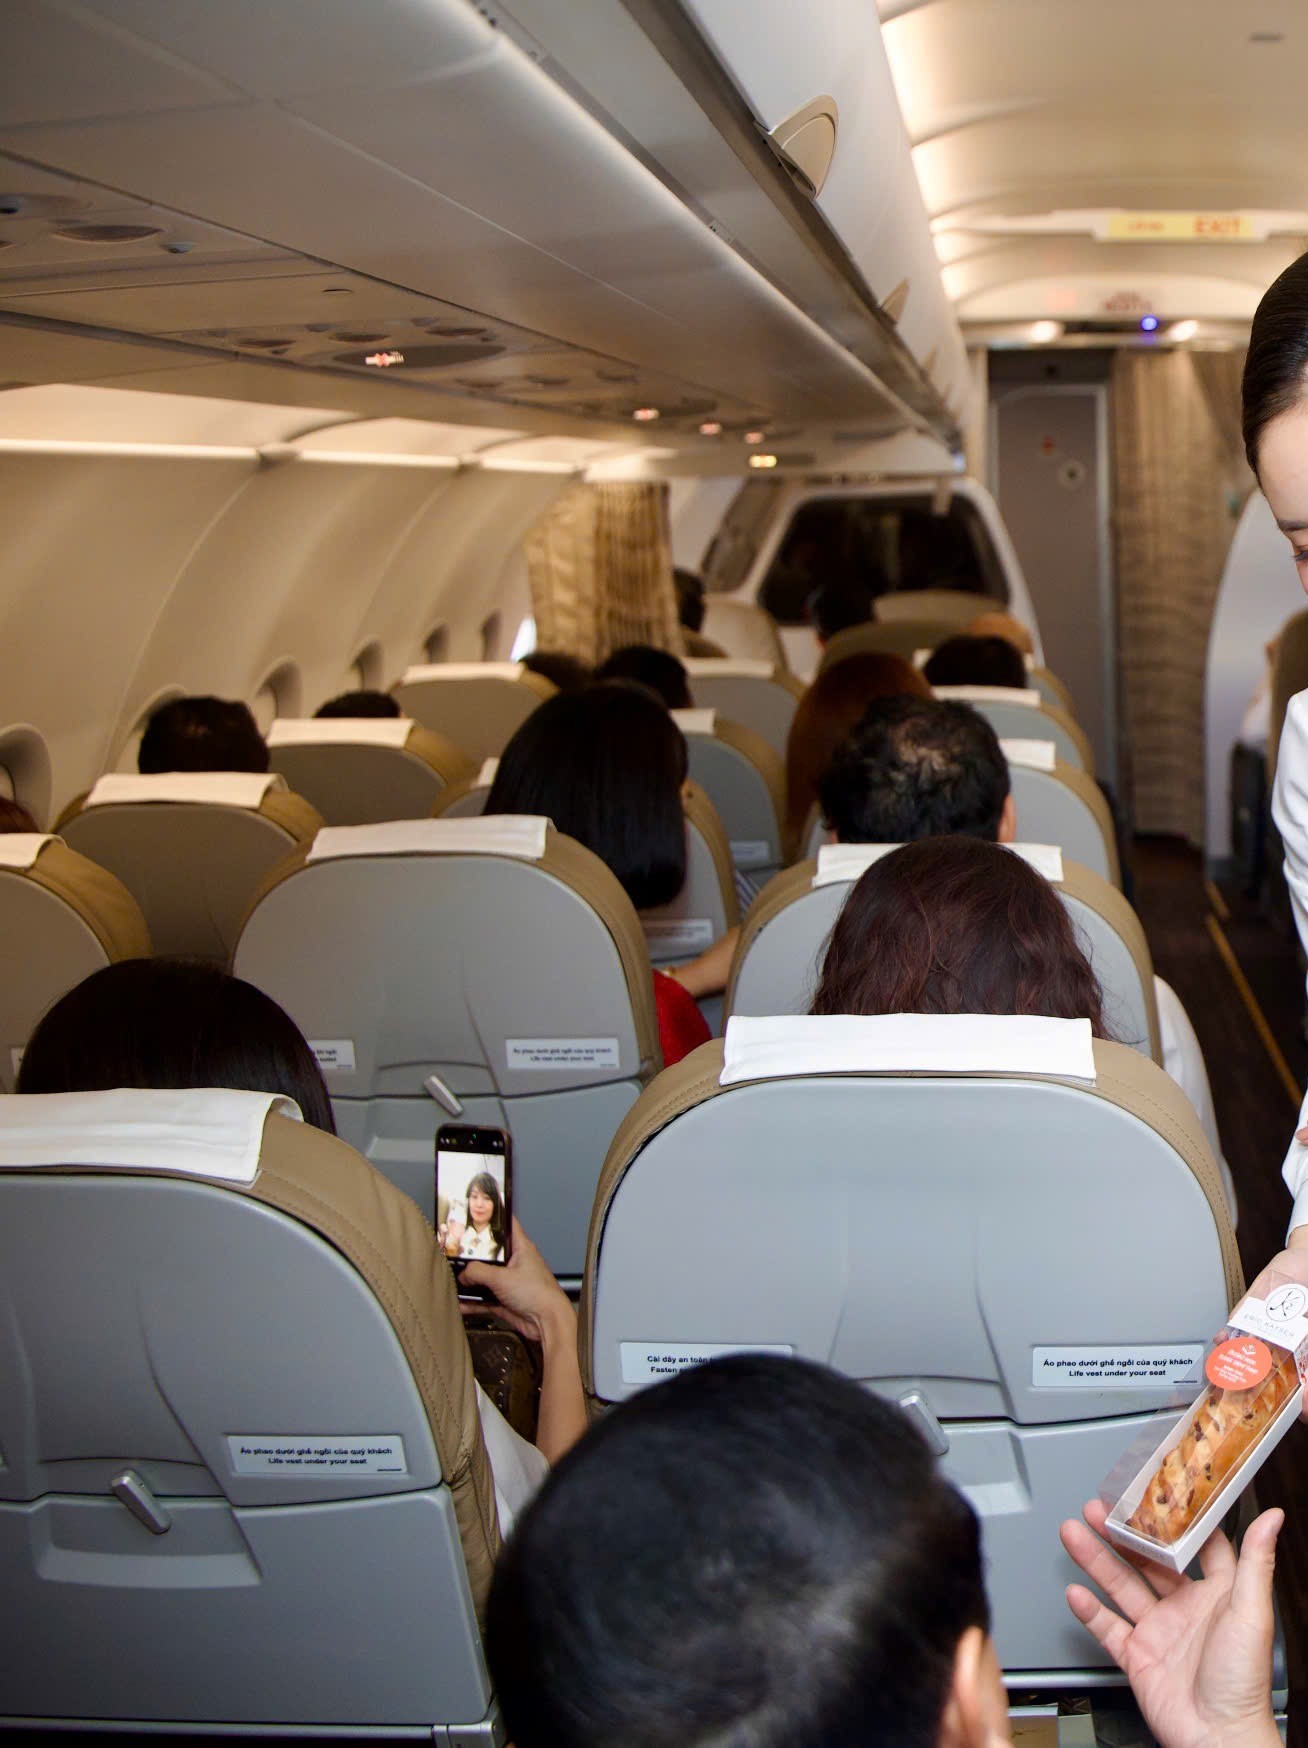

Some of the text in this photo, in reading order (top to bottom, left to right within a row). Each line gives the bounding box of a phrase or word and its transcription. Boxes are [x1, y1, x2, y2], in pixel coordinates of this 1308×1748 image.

[1194, 215, 1241, 233] EXIT
[1043, 1358, 1055, 1367] Áo
[1056, 1360, 1077, 1368] phao
[1078, 1359, 1098, 1367] dưới
[1099, 1358, 1115, 1368] ghế
[1116, 1358, 1134, 1368] ngồi
[1136, 1358, 1151, 1366] của
[1152, 1359, 1167, 1367] quý
[1104, 1369, 1127, 1377] under
[1129, 1370, 1147, 1378] your
[240, 1446, 252, 1455] Áo
[253, 1448, 274, 1456] phao
[350, 1447, 365, 1456] quý
[367, 1447, 392, 1455] khách
